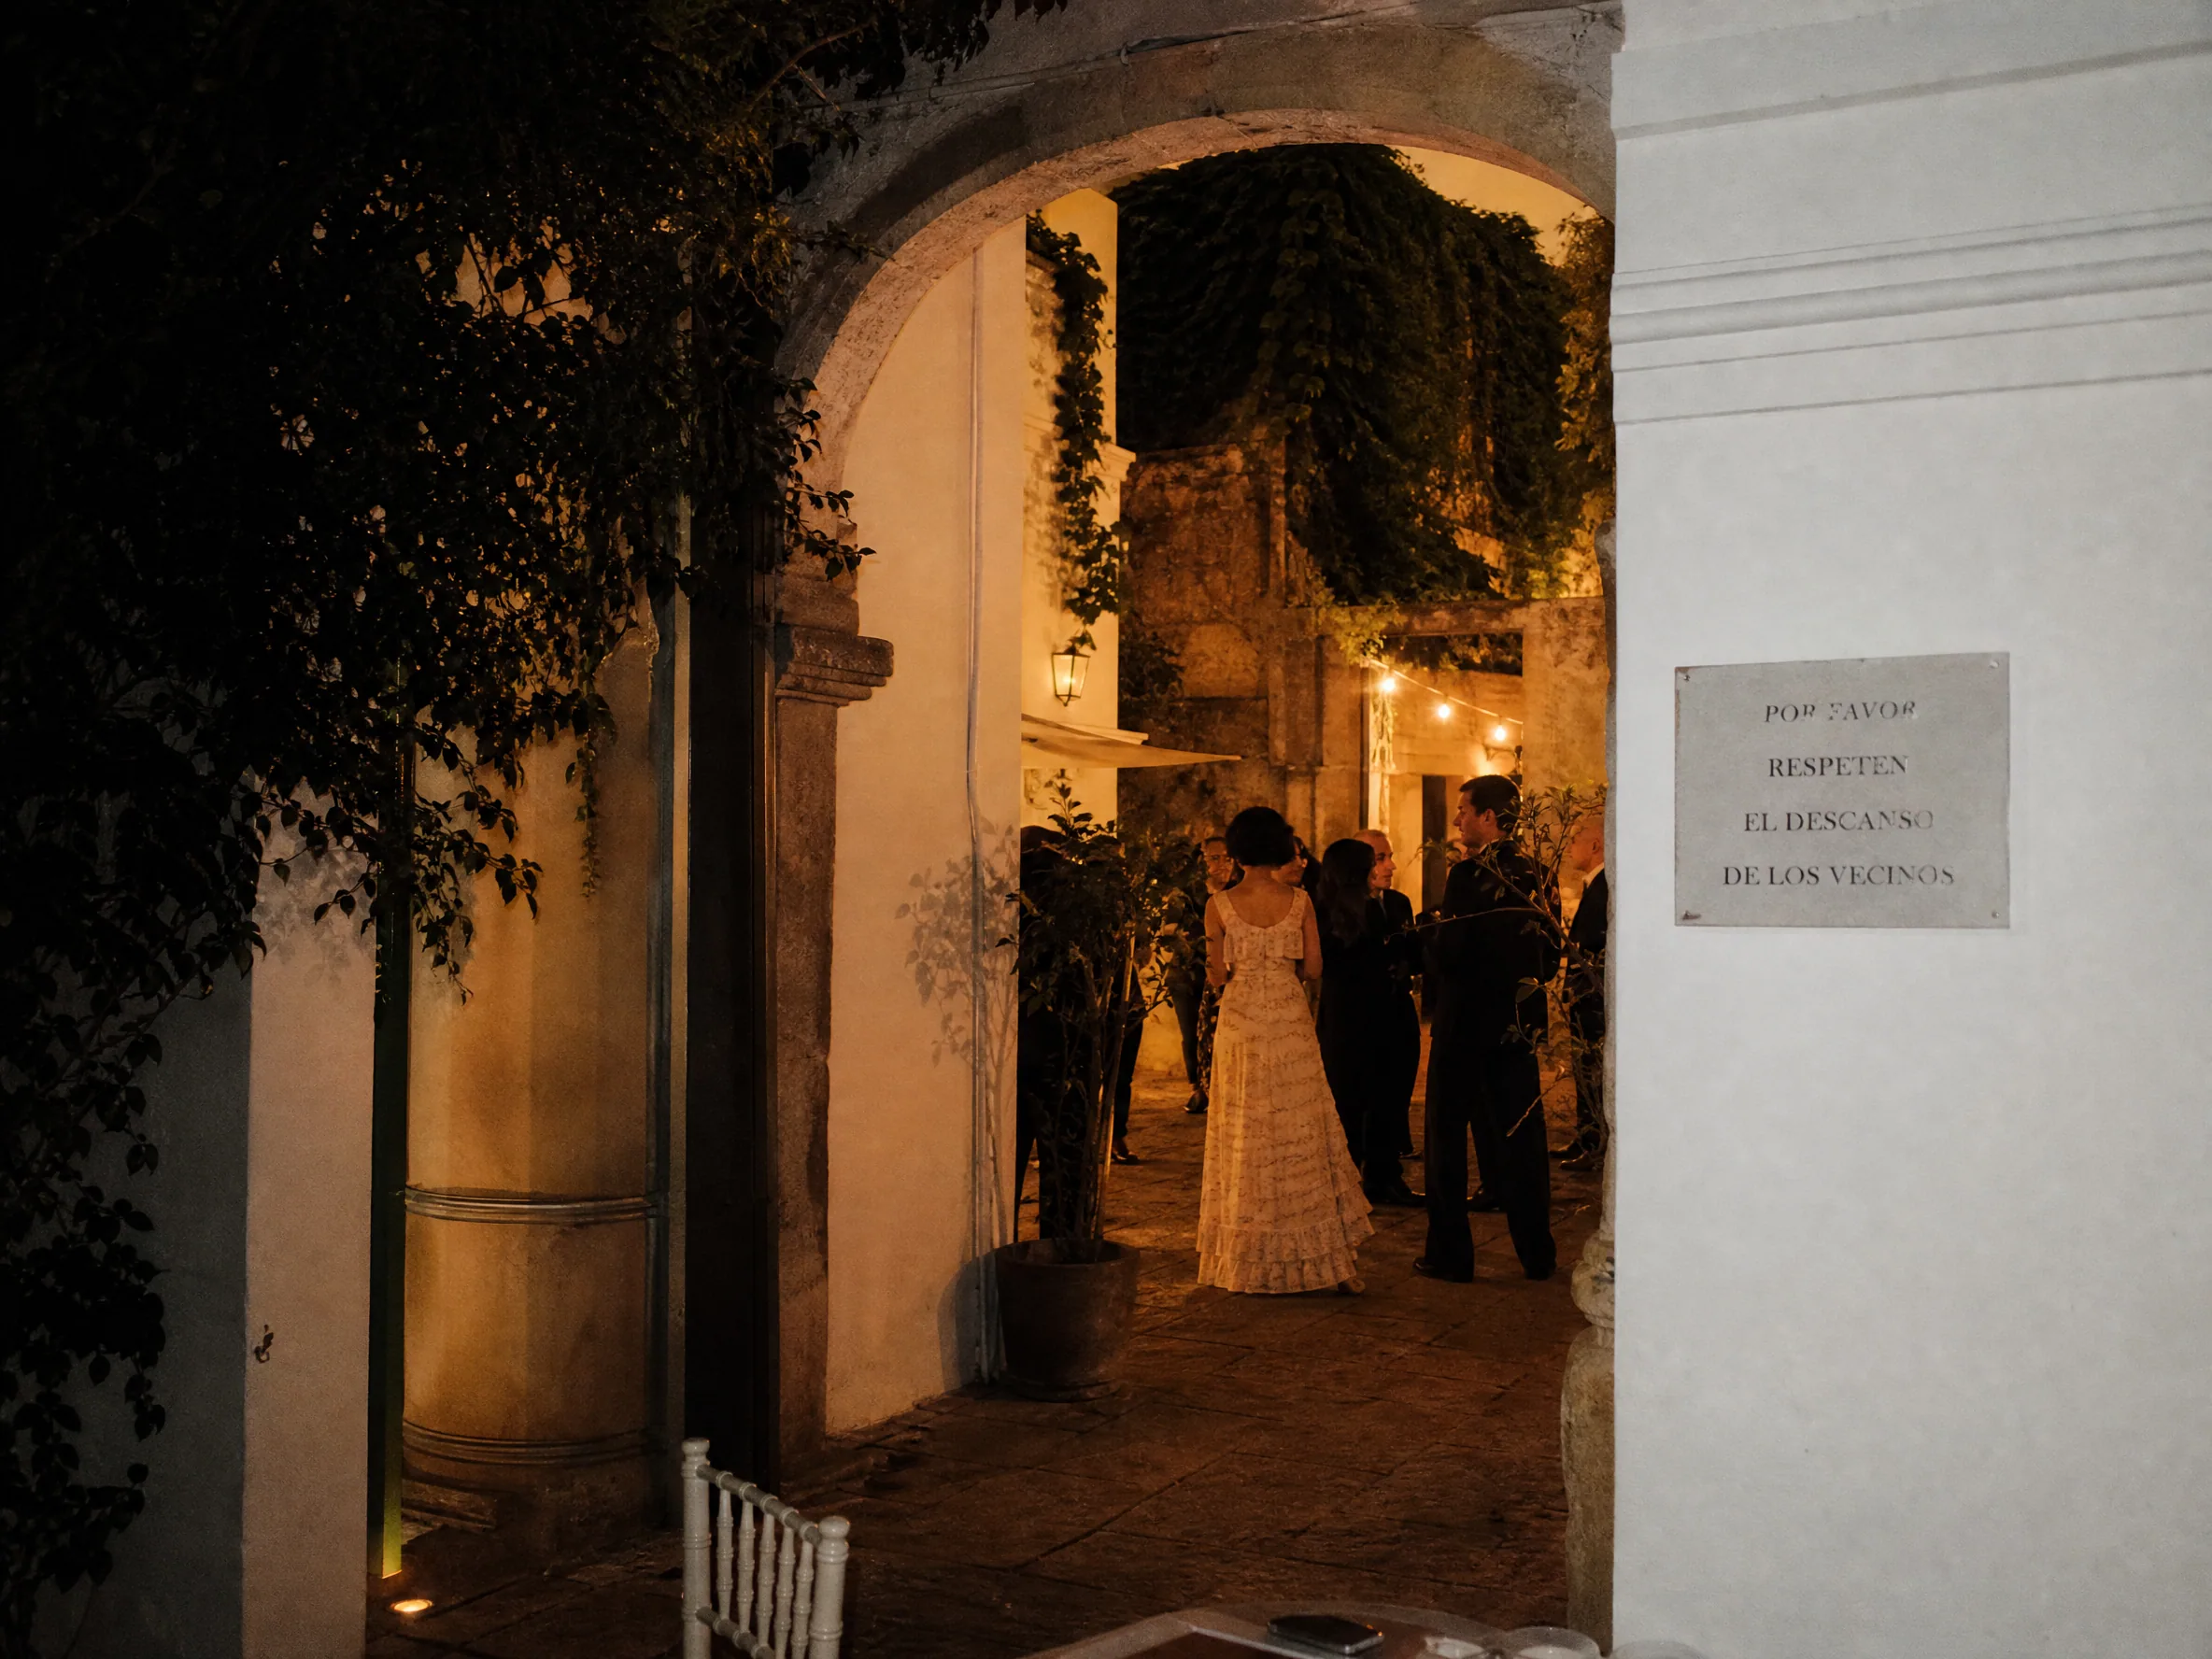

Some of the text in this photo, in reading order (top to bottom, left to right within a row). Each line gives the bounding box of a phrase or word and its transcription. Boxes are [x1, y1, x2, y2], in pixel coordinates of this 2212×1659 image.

[1765, 701, 1917, 723] POR FAVOR
[1768, 755, 1910, 778] RESPETEN
[1743, 810, 1935, 831] EL DESCANSO
[1723, 864, 1955, 886] DE LOS VECINOS
